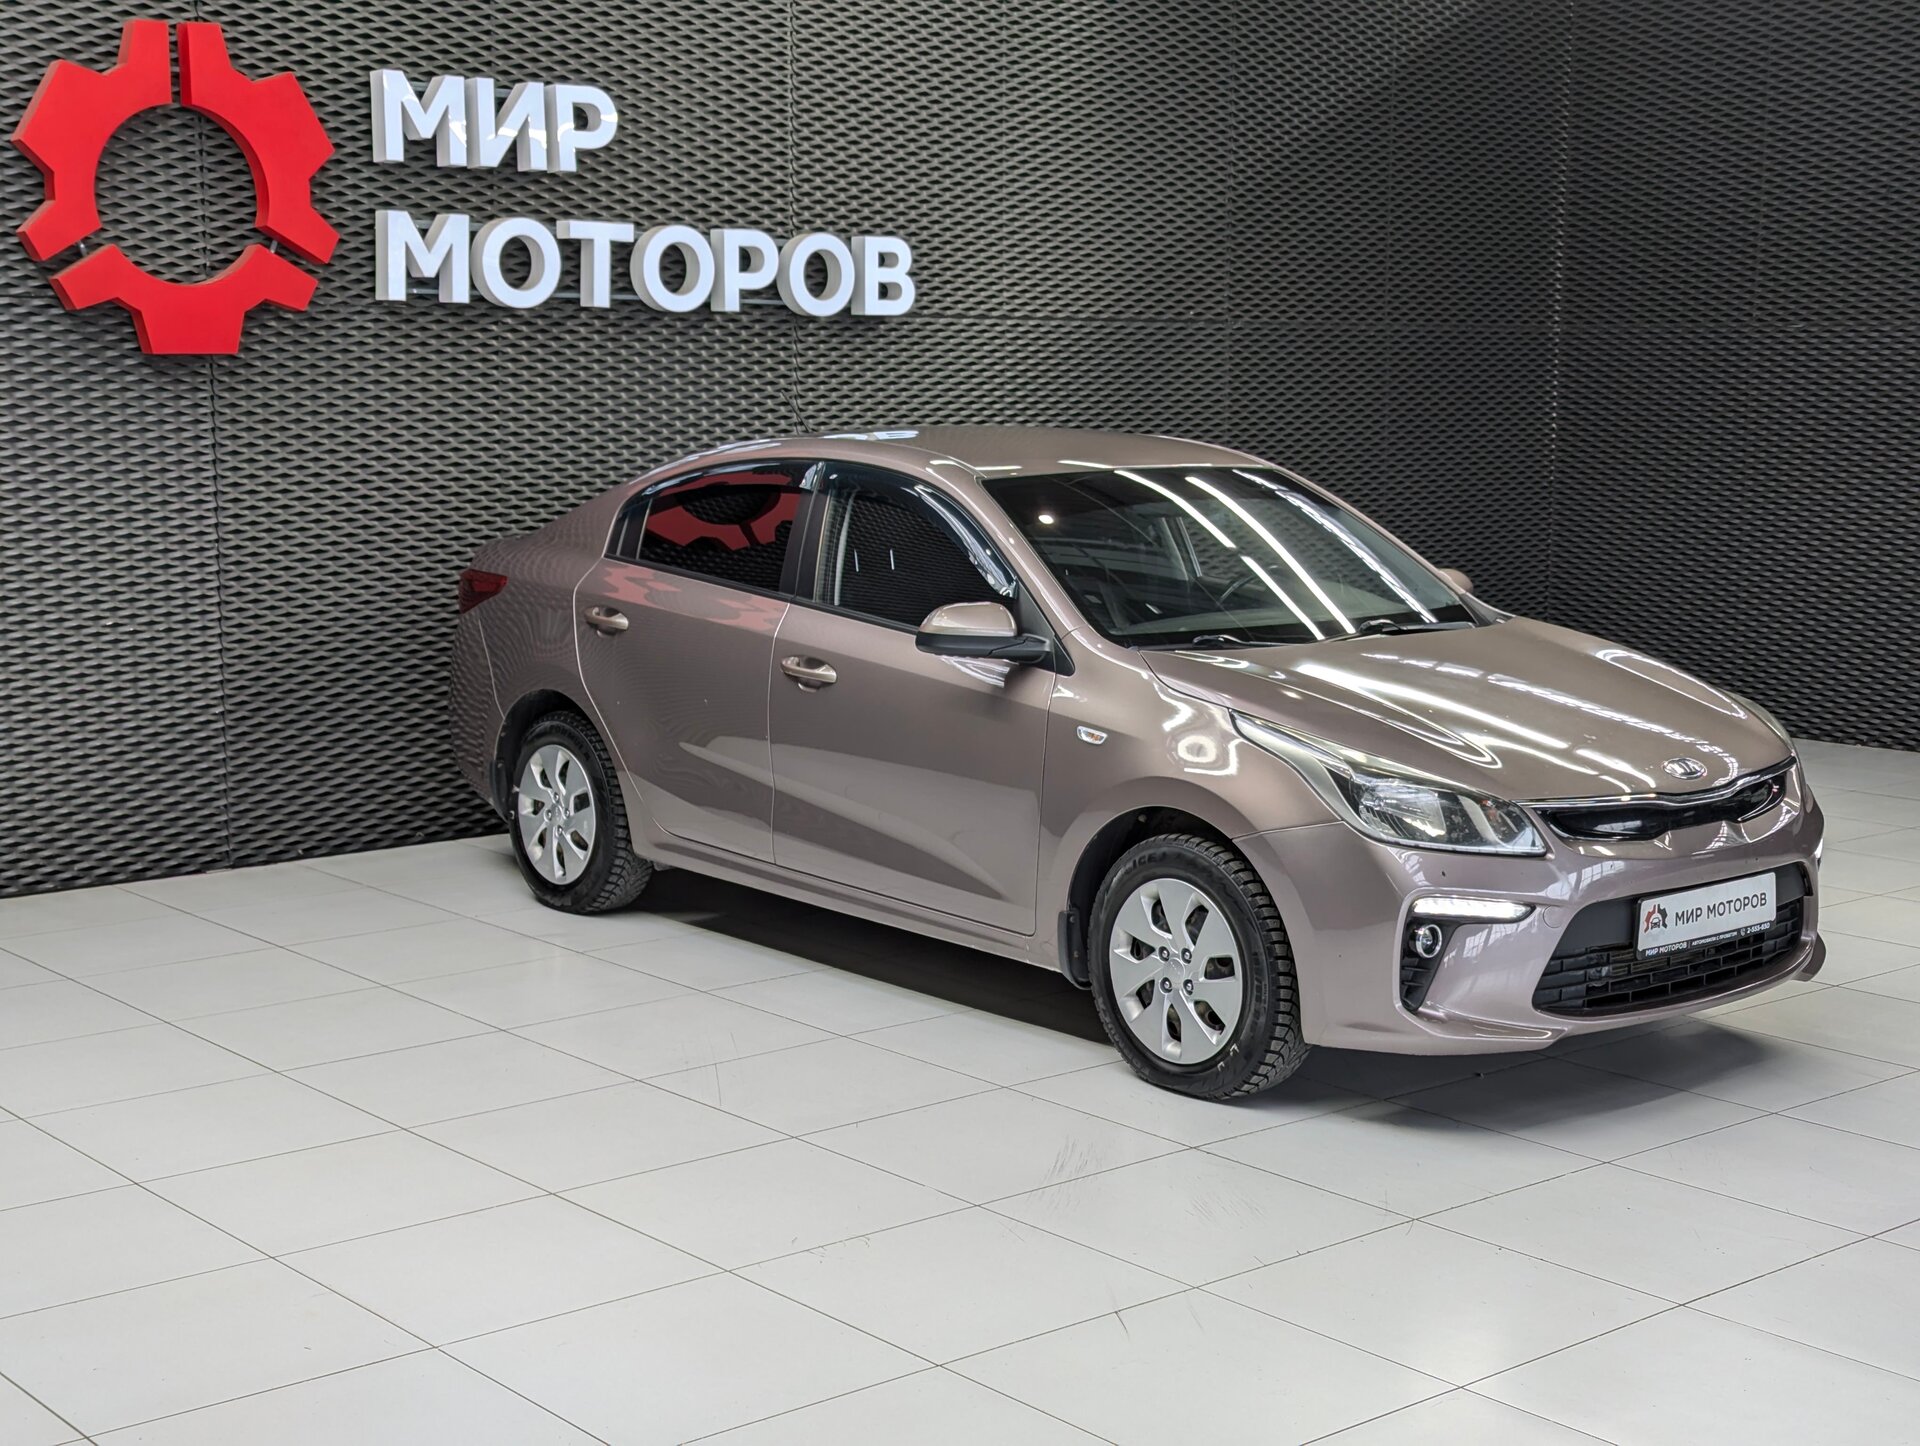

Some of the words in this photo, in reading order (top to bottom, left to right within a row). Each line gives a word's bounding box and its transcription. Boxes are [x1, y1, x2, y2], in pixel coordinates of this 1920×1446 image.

[370, 69, 619, 174] МИР
[375, 209, 916, 317] МОТОРОВ
[1675, 906, 1703, 927] МИР
[1706, 892, 1767, 920] МОТОРОВ
[1645, 947, 1659, 957] МИР
[1659, 941, 1688, 954] МОТОРОВ
